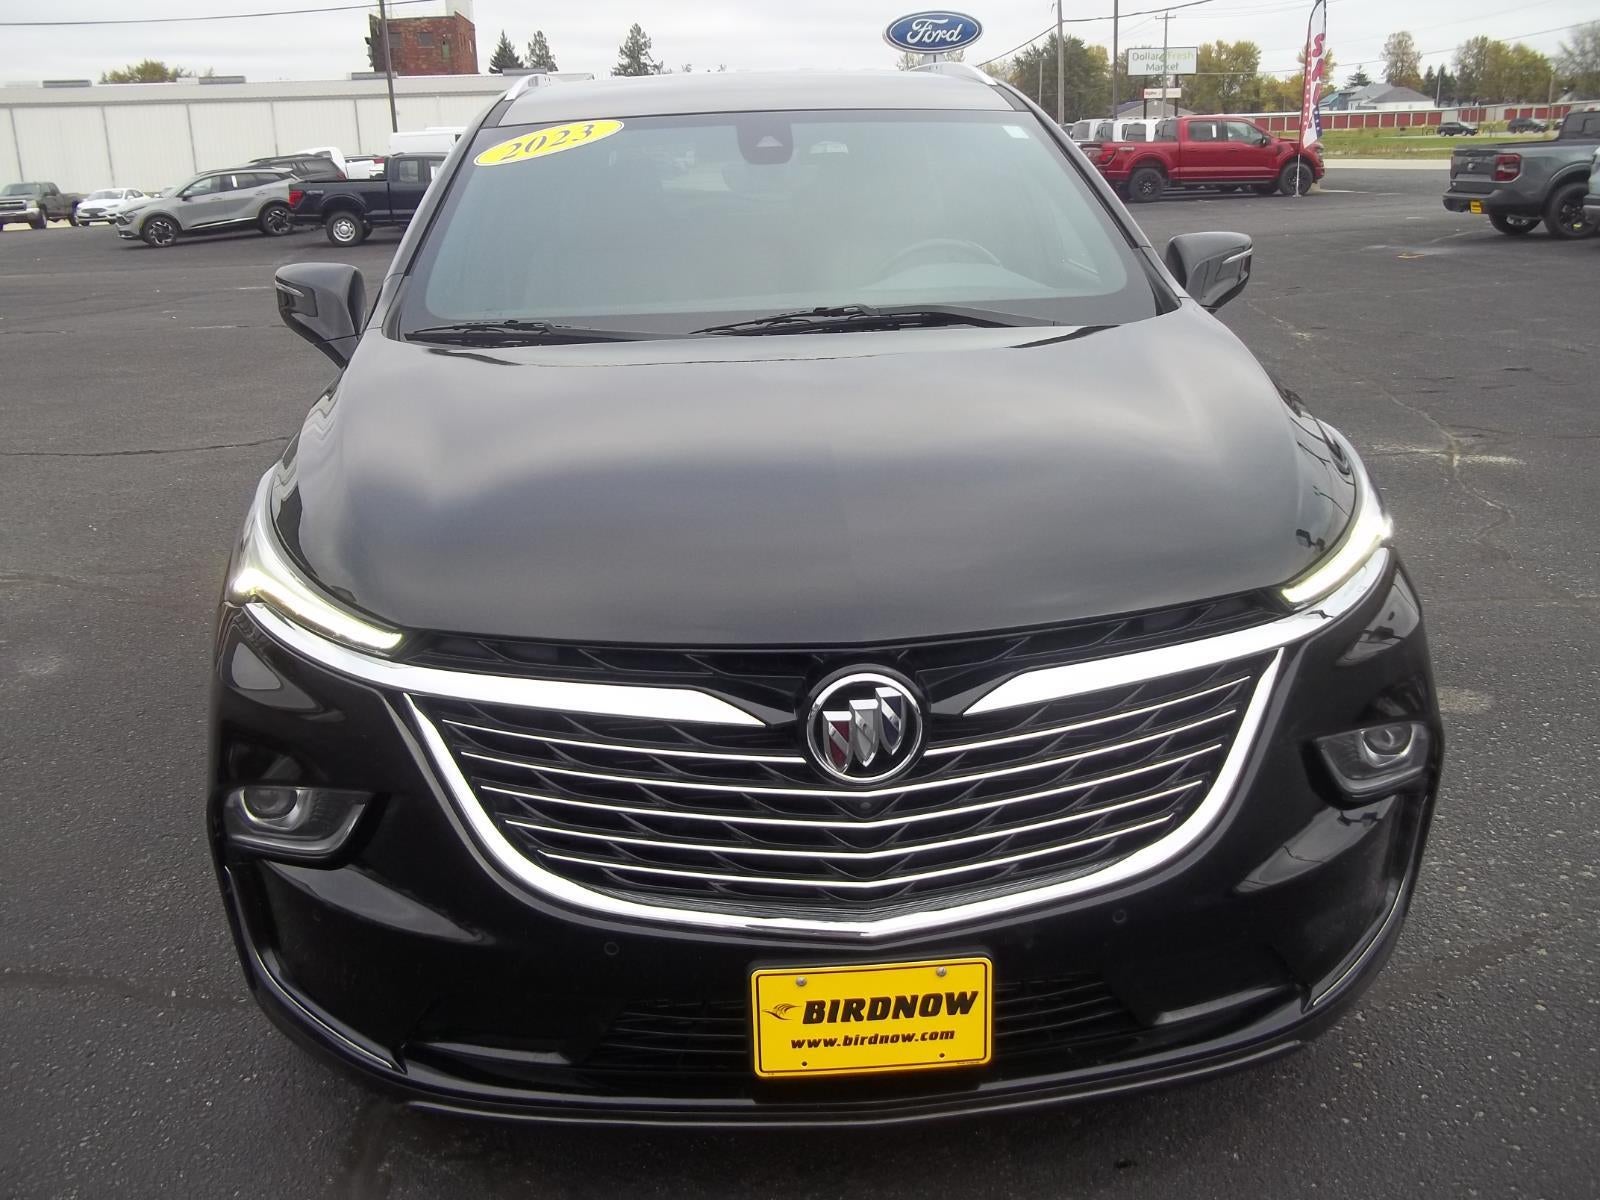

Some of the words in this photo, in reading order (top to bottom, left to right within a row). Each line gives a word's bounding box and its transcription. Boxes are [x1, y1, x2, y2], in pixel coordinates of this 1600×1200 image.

[906, 18, 963, 43] Ford
[1132, 51, 1159, 61] Dollar
[501, 124, 595, 160] 2023
[802, 990, 979, 1025] BIRDNOW
[790, 1029, 955, 1049] www.birdnow.com
